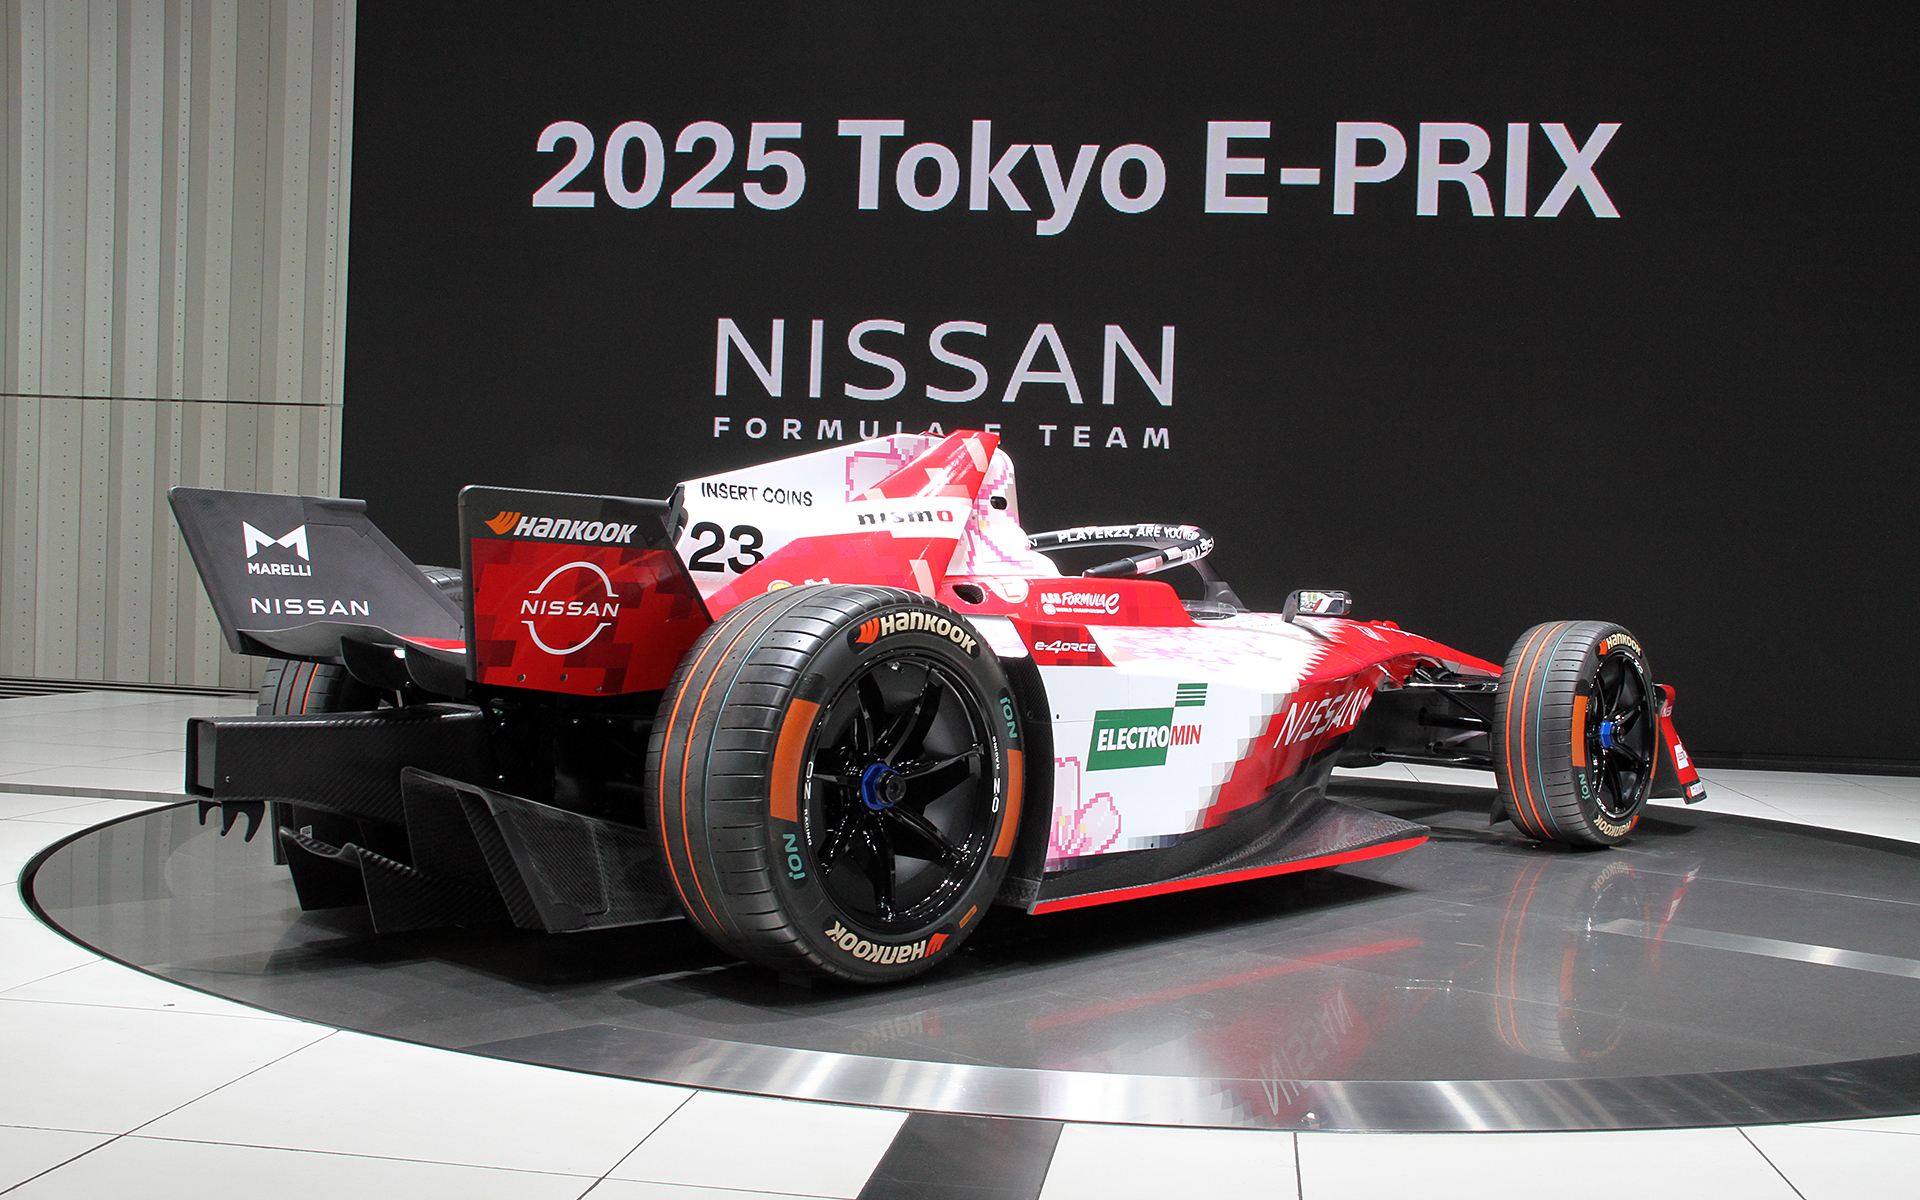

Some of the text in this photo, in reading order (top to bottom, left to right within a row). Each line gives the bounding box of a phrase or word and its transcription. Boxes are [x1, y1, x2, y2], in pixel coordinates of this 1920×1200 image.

[532, 118, 1622, 236] 2025 Tokyo E-PRIX
[714, 317, 1175, 407] NISSAN
[1038, 424, 1171, 450] TEAM
[701, 482, 813, 507] INSERT COINS
[857, 510, 954, 526] nismo
[1057, 528, 1134, 543] PLAYER23,
[1136, 527, 1162, 538] ARE
[1163, 526, 1184, 540] YOU
[689, 521, 765, 575] 23
[247, 562, 313, 577] MARELLI
[250, 597, 370, 616] NISSAN
[520, 599, 620, 618] NISSAN
[1061, 591, 1107, 608] FORMULA
[1273, 686, 1369, 749] NISSAN
[1097, 724, 1202, 751] ELECTROMIN
